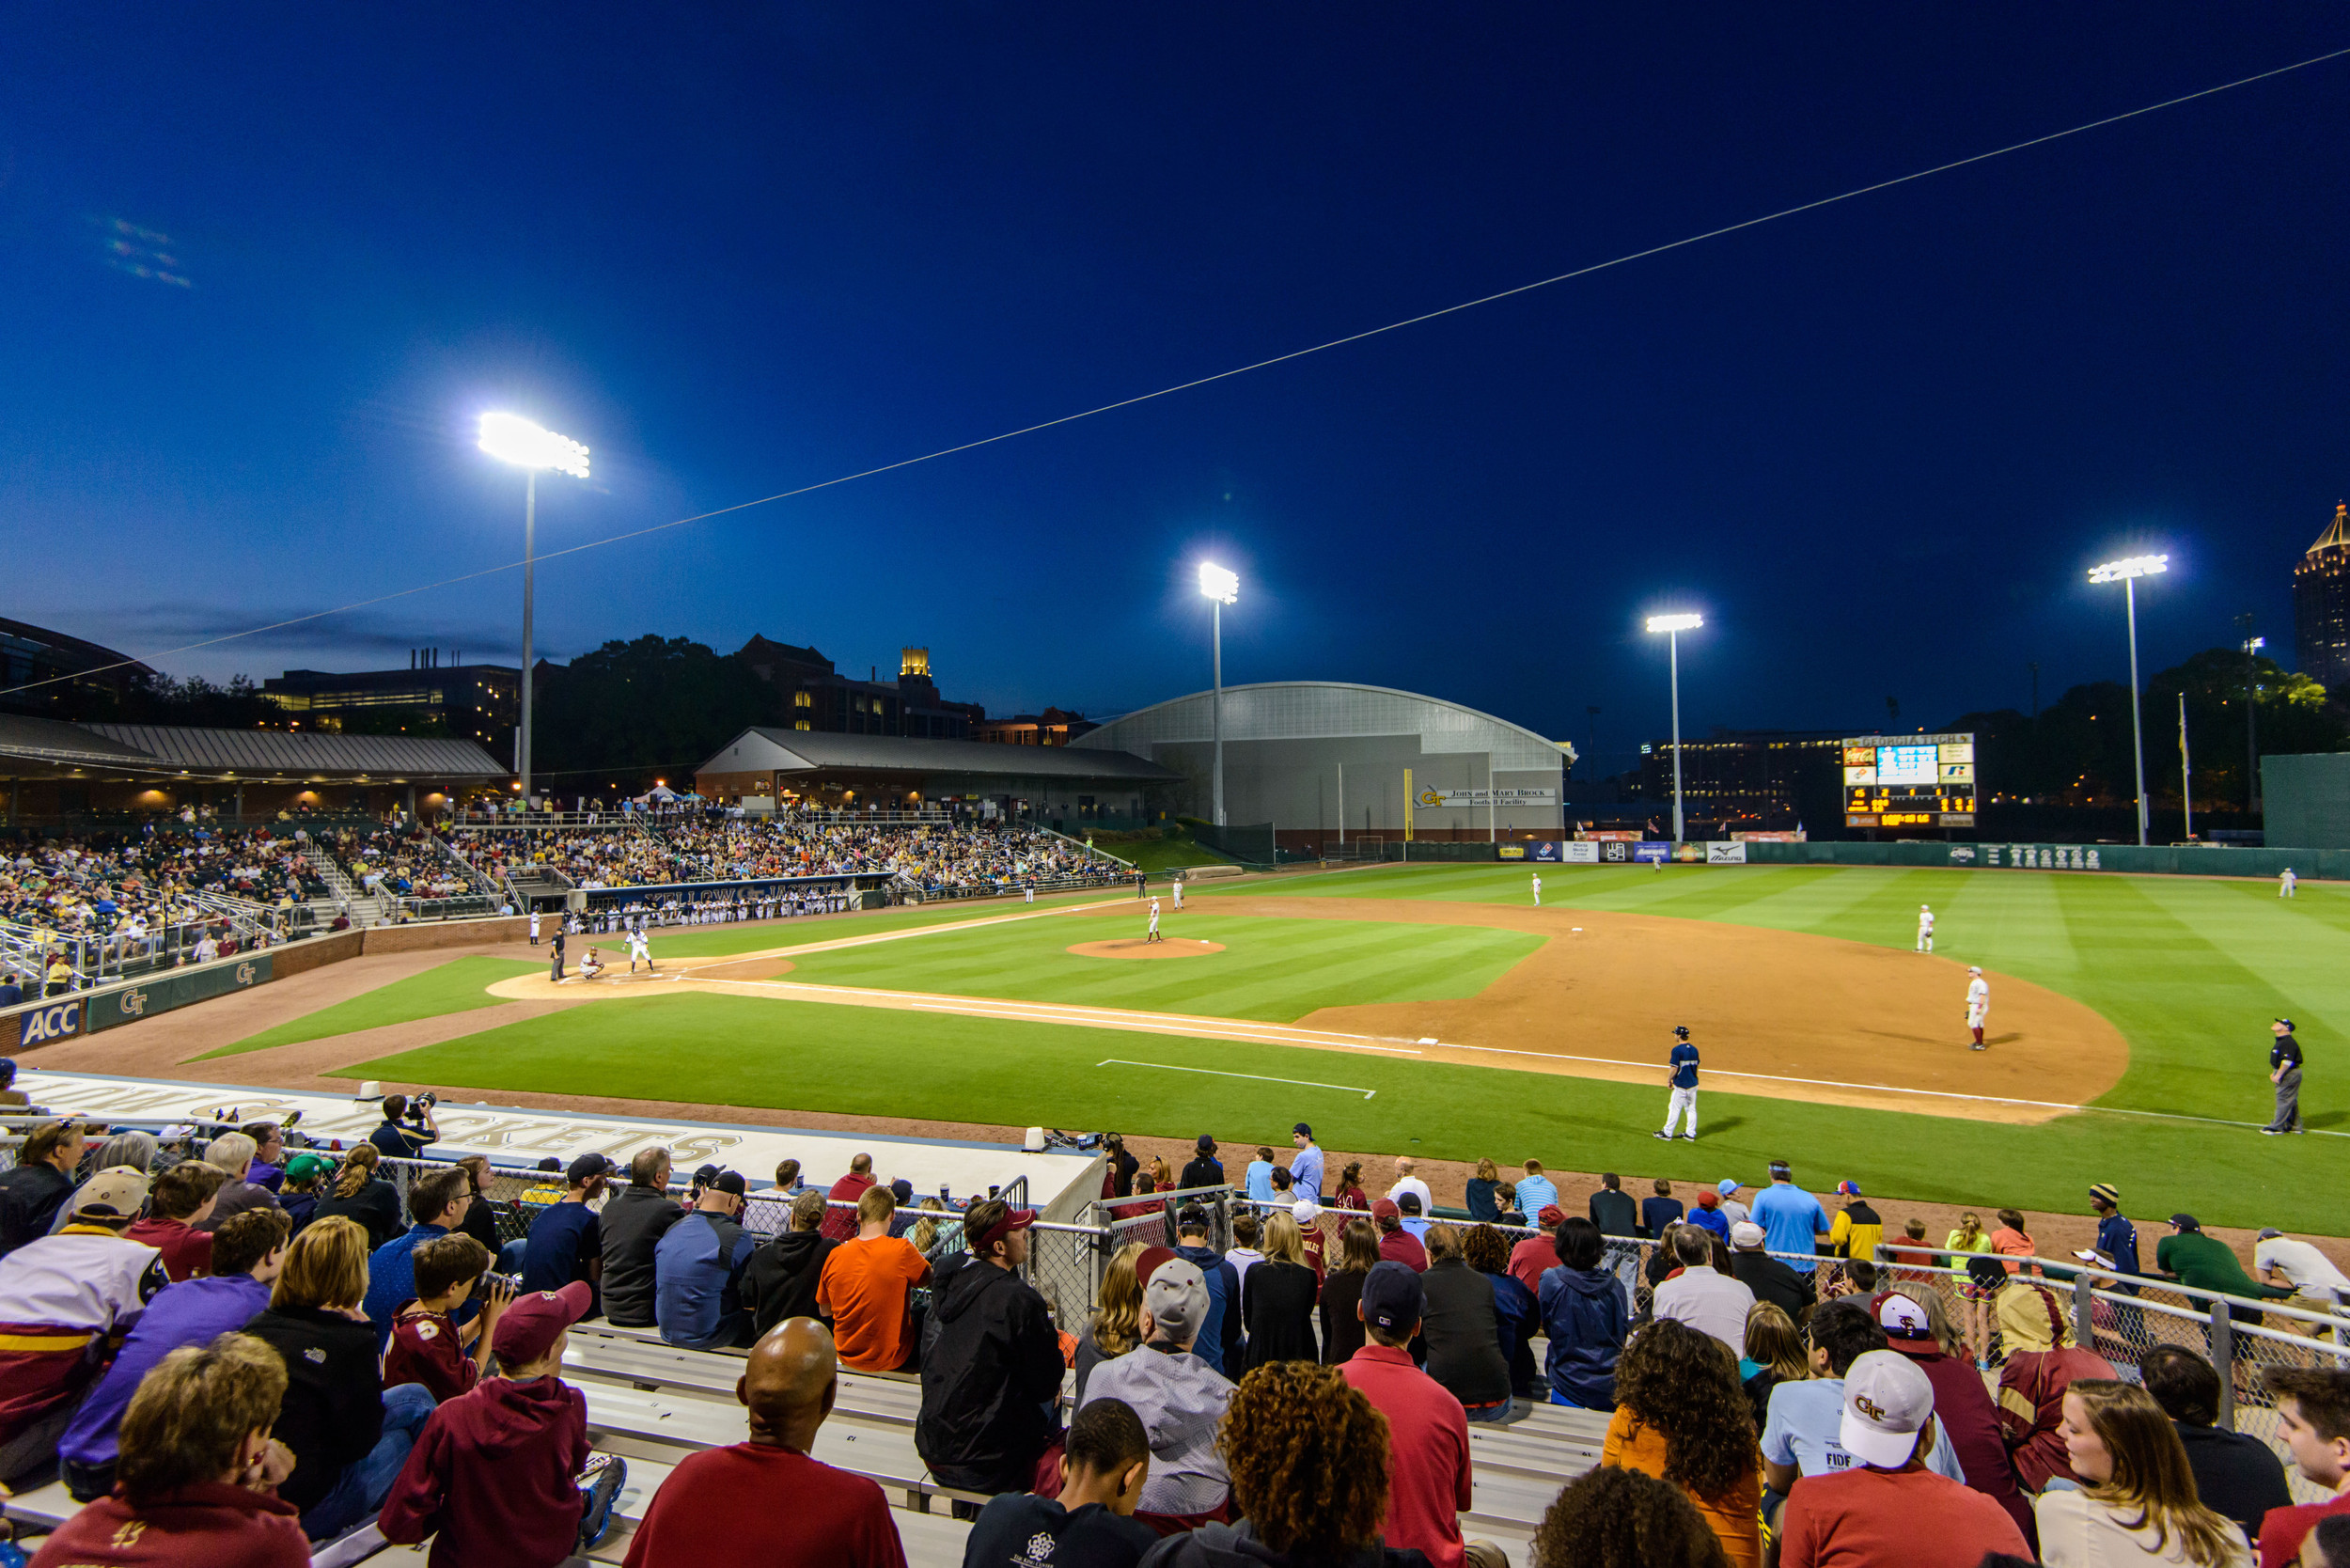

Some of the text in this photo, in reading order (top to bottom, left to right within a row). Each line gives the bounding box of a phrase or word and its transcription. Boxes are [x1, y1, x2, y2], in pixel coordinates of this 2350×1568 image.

[1862, 735, 1919, 746] GEORGIA
[1920, 734, 1955, 744] TECH
[1421, 792, 1446, 806] GT
[236, 963, 256, 984] GT
[120, 989, 147, 1015] GT
[23, 1002, 80, 1045] ACC
[1855, 1395, 1885, 1421] GT
